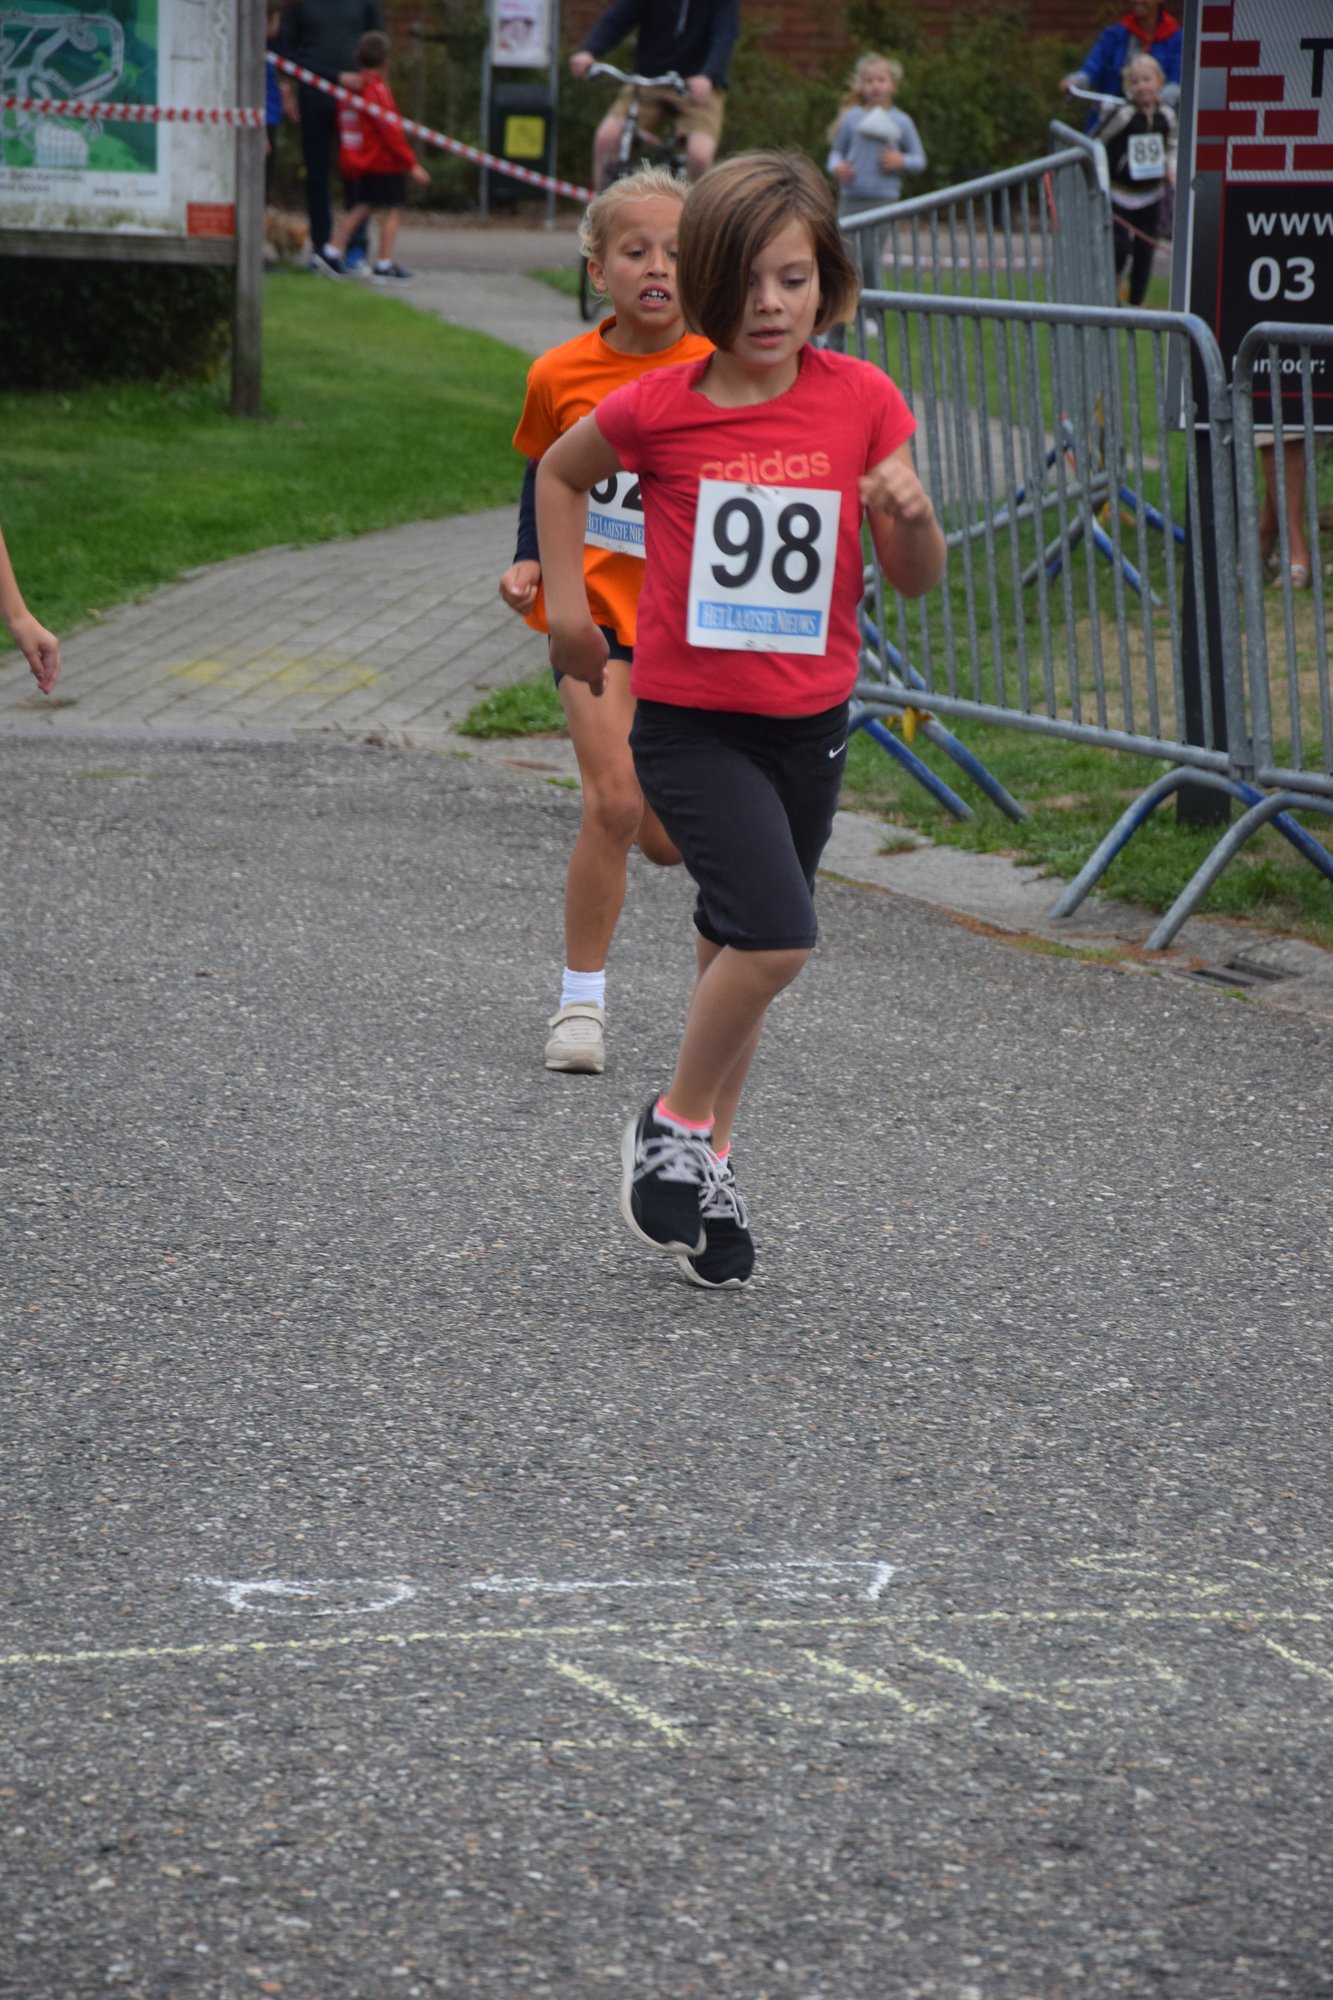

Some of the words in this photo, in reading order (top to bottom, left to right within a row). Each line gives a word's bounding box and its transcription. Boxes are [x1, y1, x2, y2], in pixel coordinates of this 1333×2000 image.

[1300, 38, 1333, 97] T
[1134, 138, 1161, 164] 89
[1248, 256, 1316, 302] 03
[698, 449, 832, 482] adidas
[599, 515, 629, 540] LAATSTE
[710, 497, 822, 594] 98
